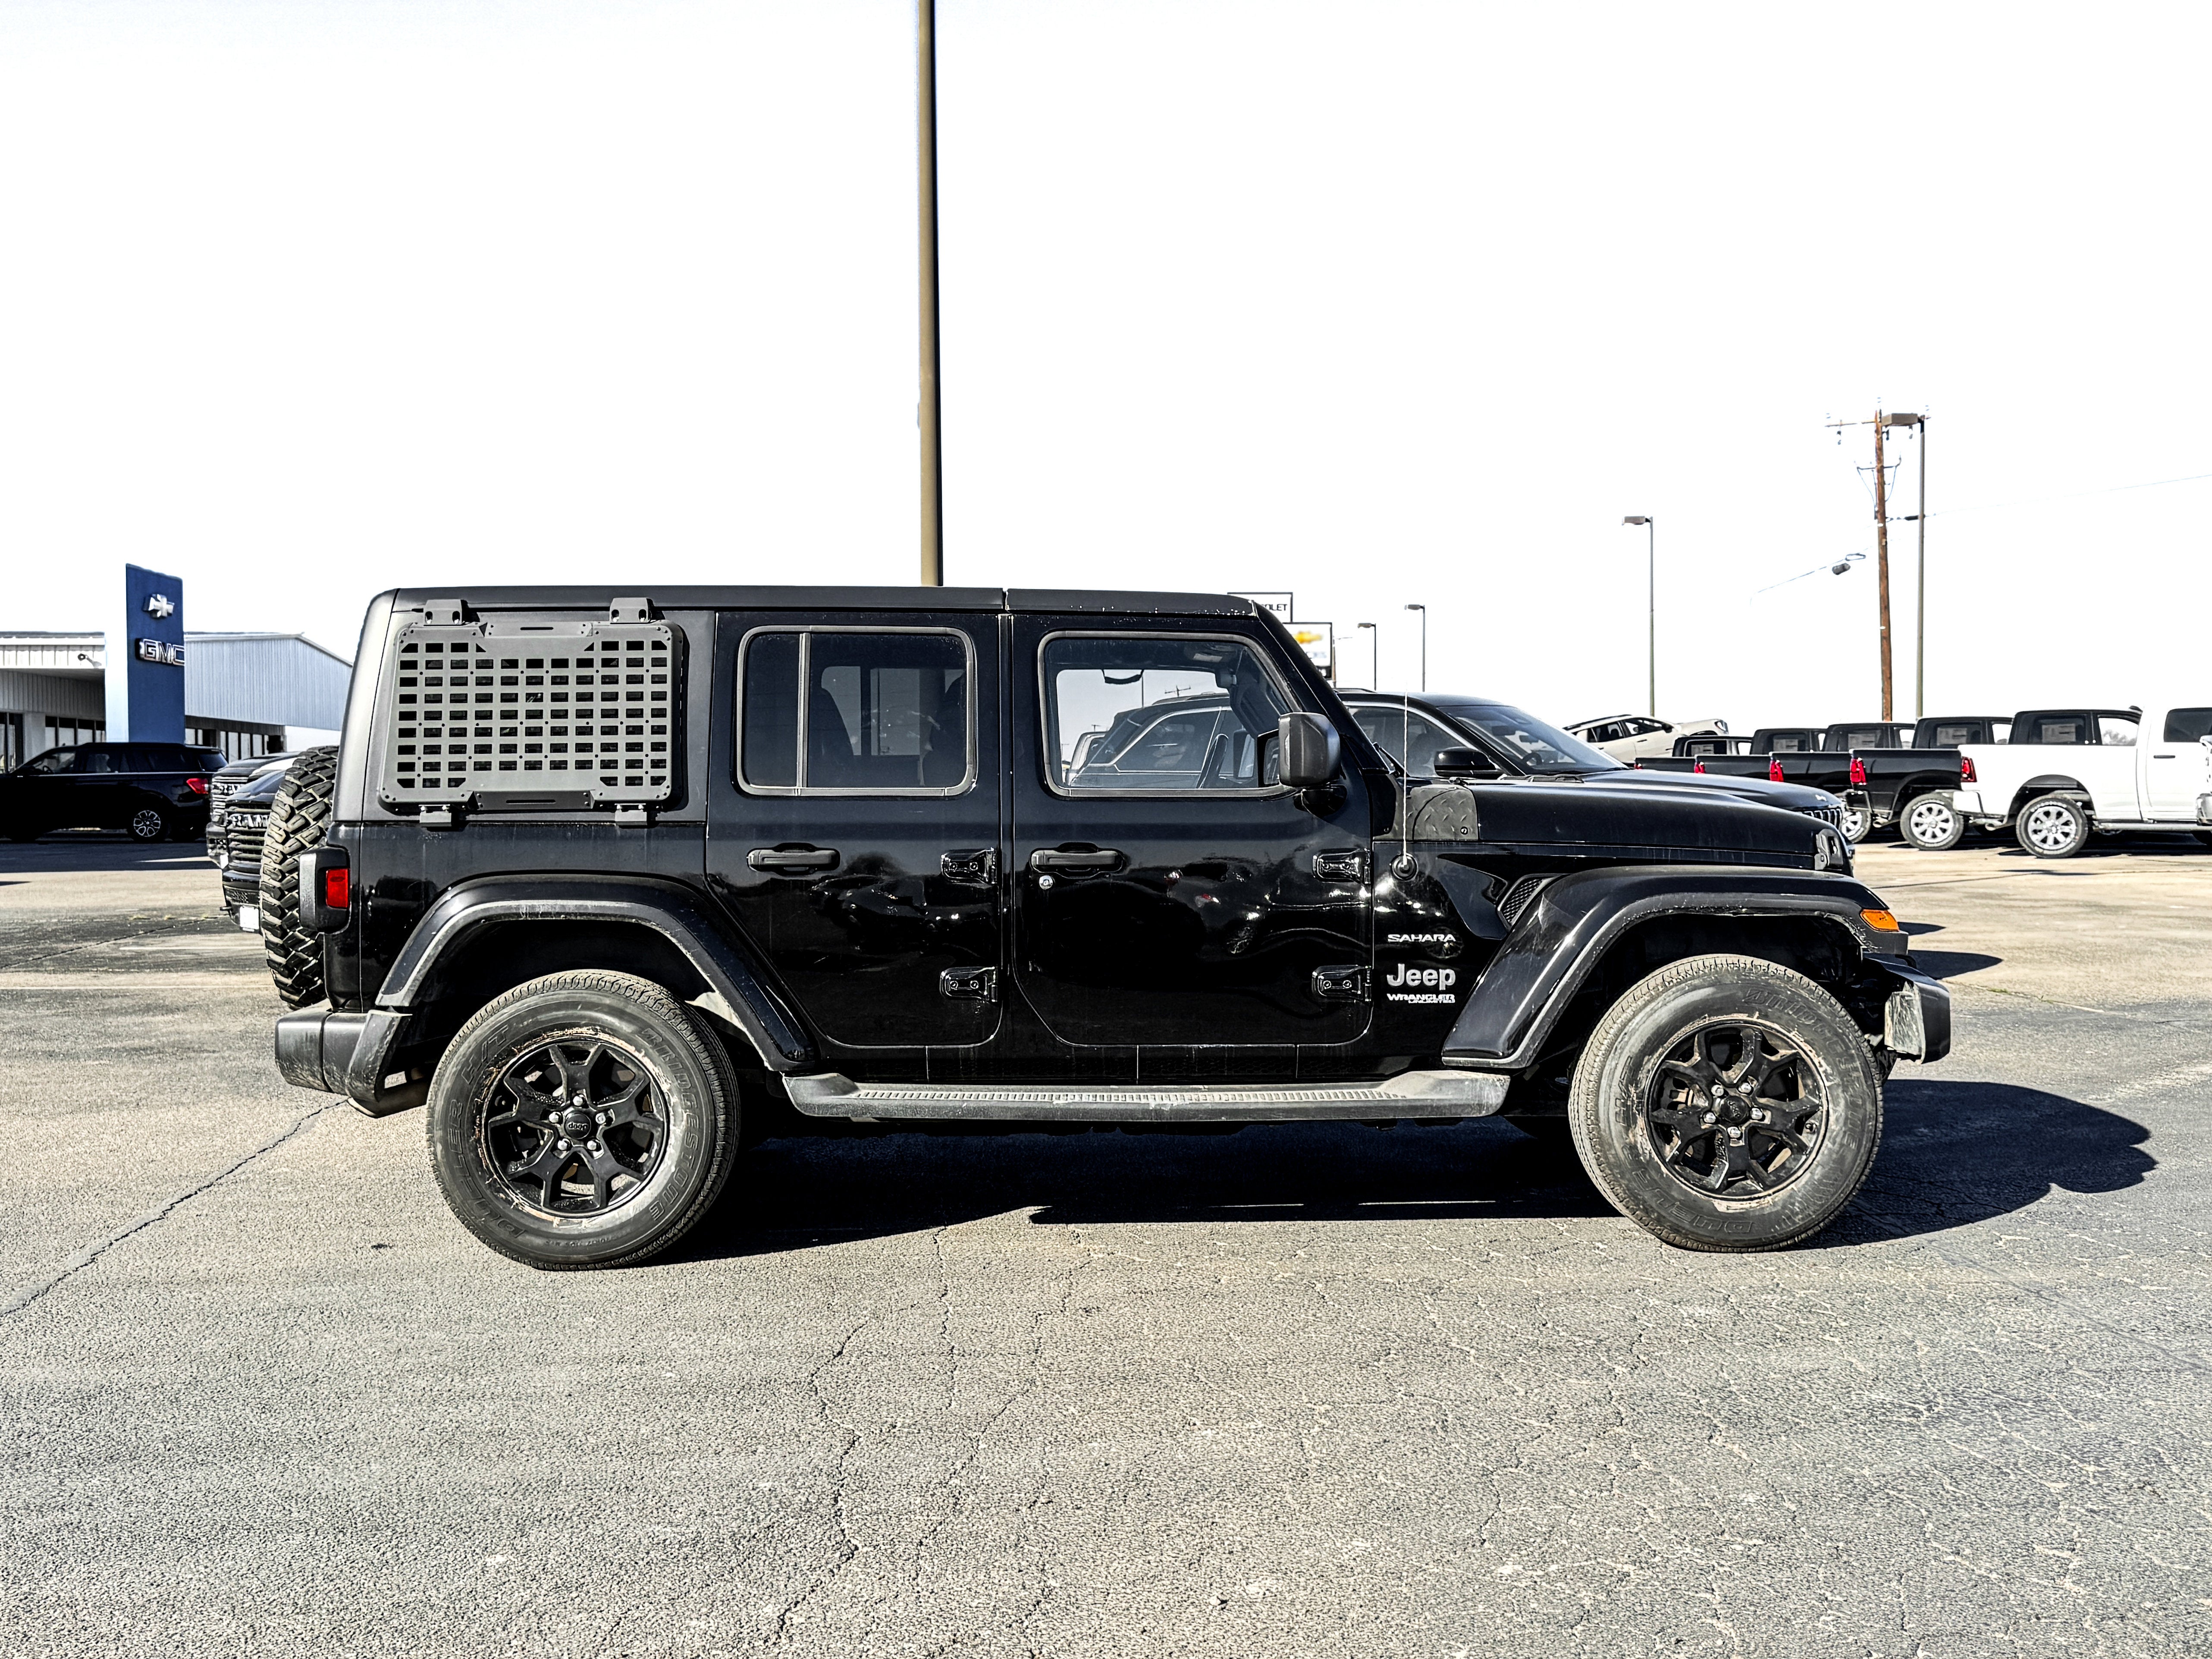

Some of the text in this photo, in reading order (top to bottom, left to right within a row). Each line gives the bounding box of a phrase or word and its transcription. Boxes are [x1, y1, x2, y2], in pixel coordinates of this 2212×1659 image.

[141, 639, 185, 665] GMC
[1387, 934, 1456, 942] SAHARA
[1387, 963, 1456, 991] Jeep
